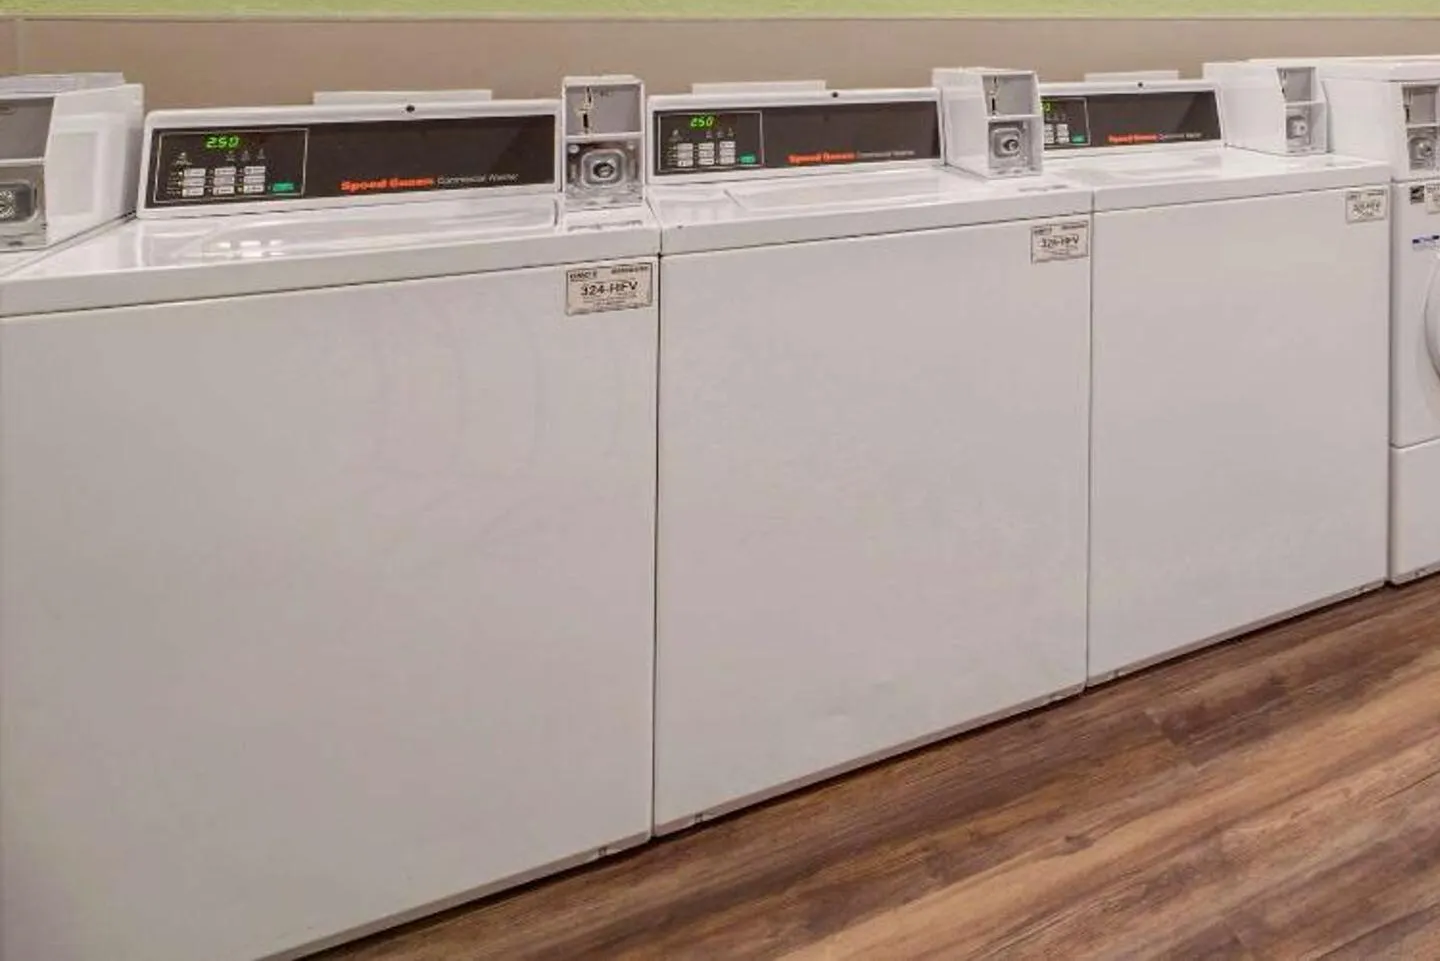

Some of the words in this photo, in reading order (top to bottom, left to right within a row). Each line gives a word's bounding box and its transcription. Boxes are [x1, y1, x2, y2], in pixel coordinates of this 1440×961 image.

[690, 116, 714, 128] 250
[206, 136, 240, 148] 250
[340, 179, 387, 192] Speed
